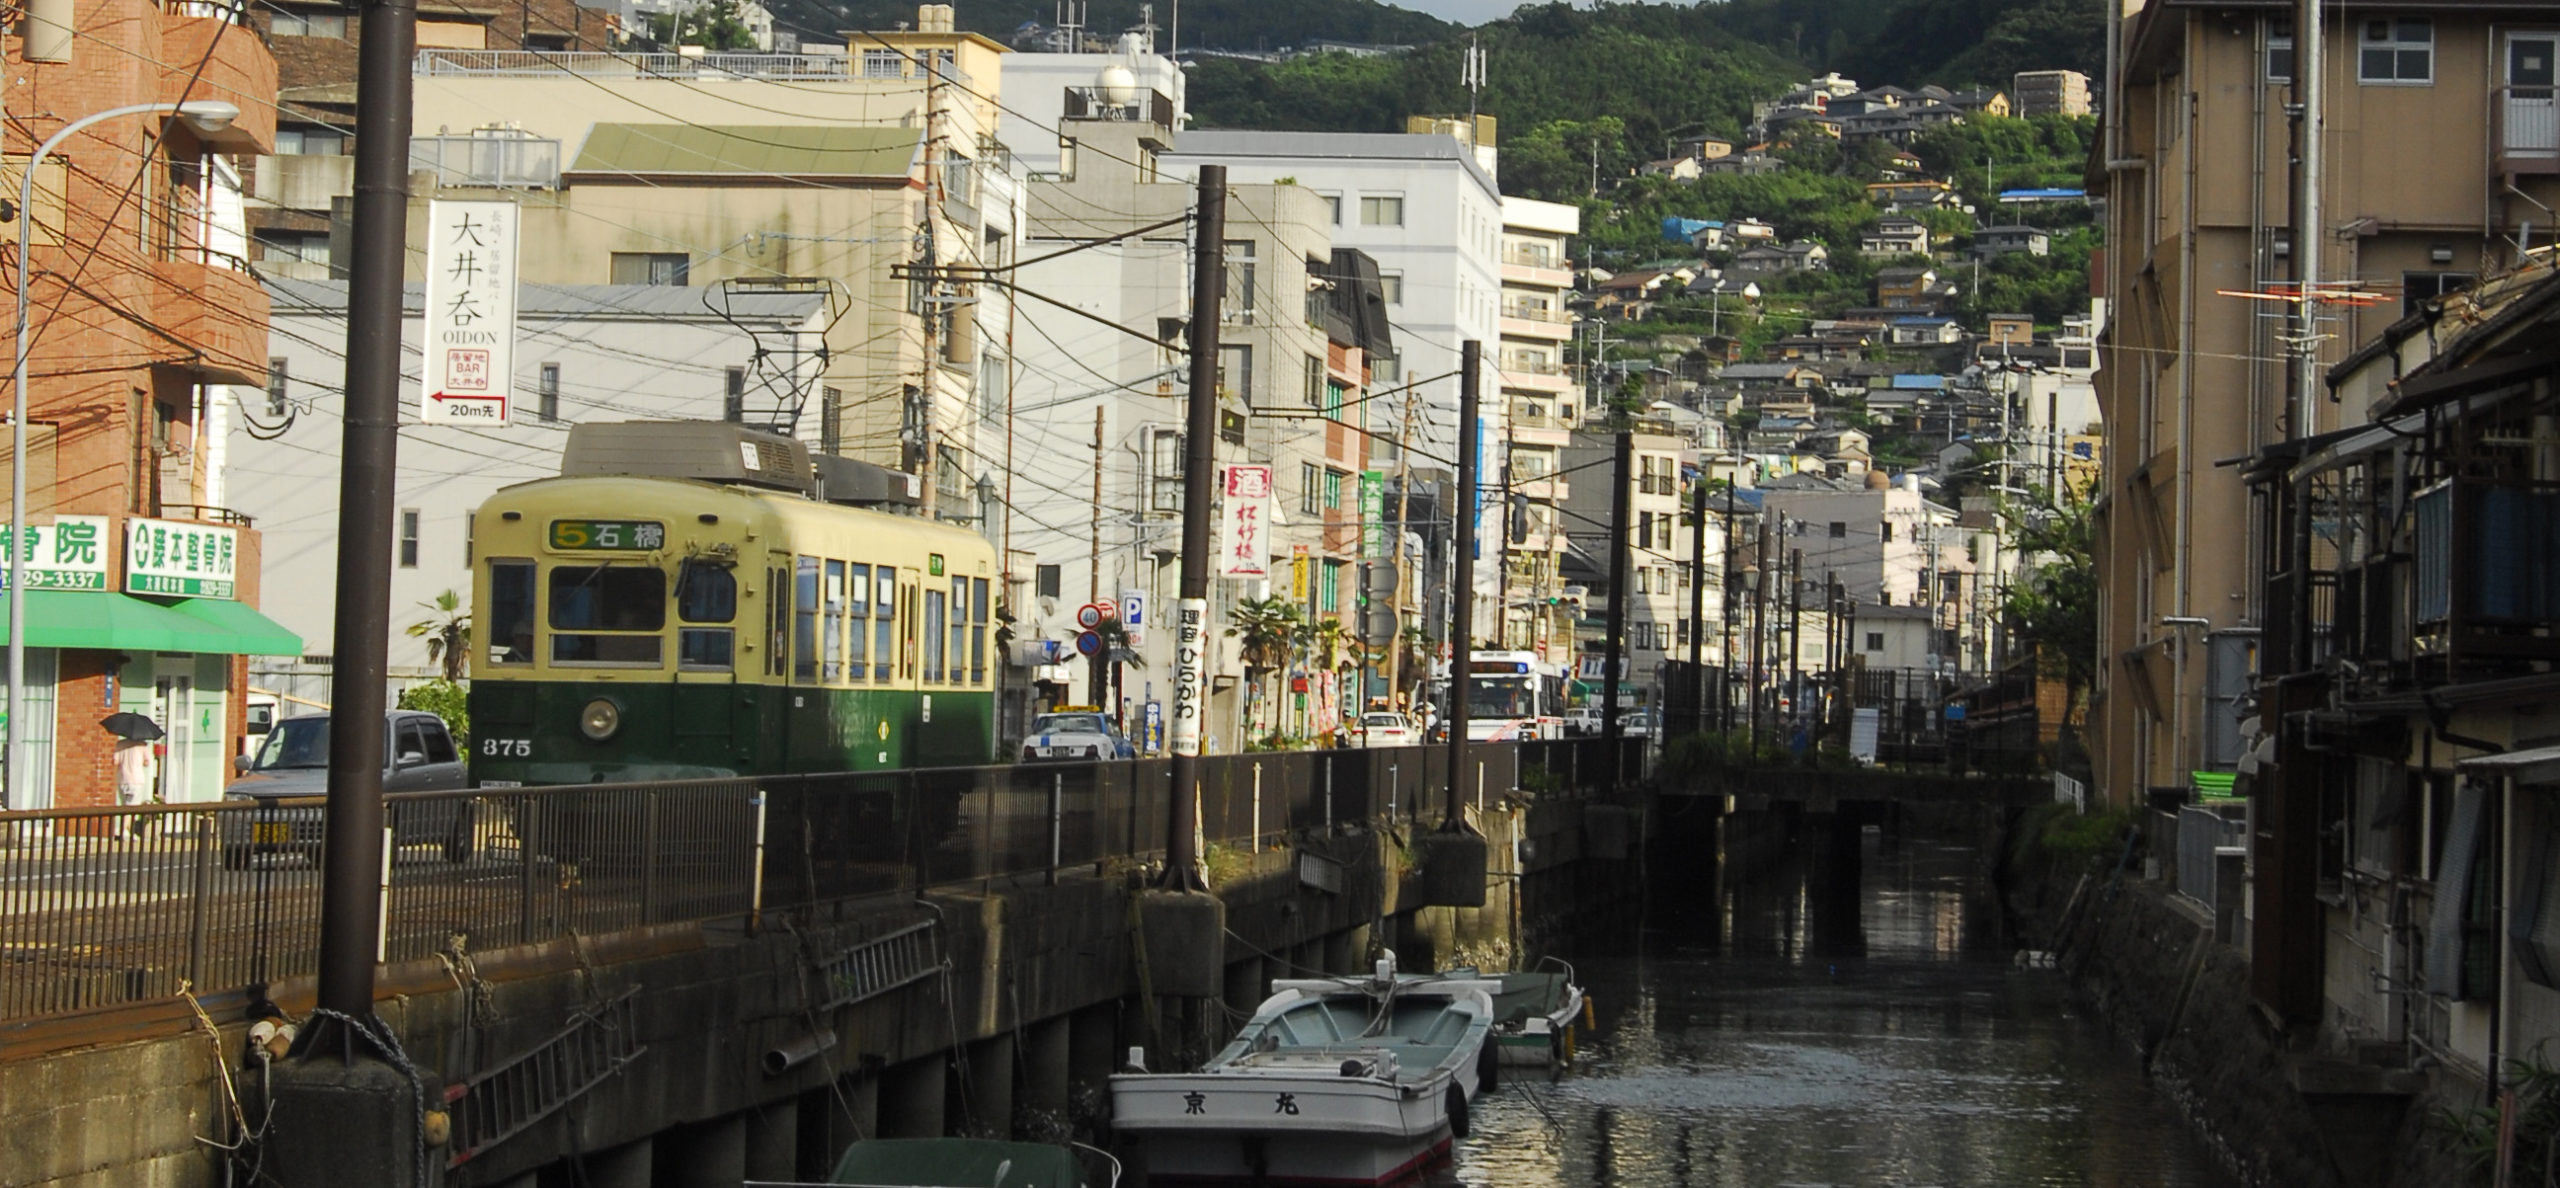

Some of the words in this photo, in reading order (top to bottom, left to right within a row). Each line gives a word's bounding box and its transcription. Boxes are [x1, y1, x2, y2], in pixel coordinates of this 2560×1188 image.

[446, 212, 486, 328] 大井呑
[443, 331, 500, 344] OIDON
[456, 363, 480, 374] BAR
[450, 404, 495, 418] 20m先
[1233, 467, 1267, 495] 酒
[556, 522, 588, 547] 5
[594, 523, 663, 548] 石橋
[1235, 502, 1258, 560] 松竹梅
[1082, 610, 1099, 623] 40
[1125, 598, 1141, 623] P
[483, 739, 531, 757] 375
